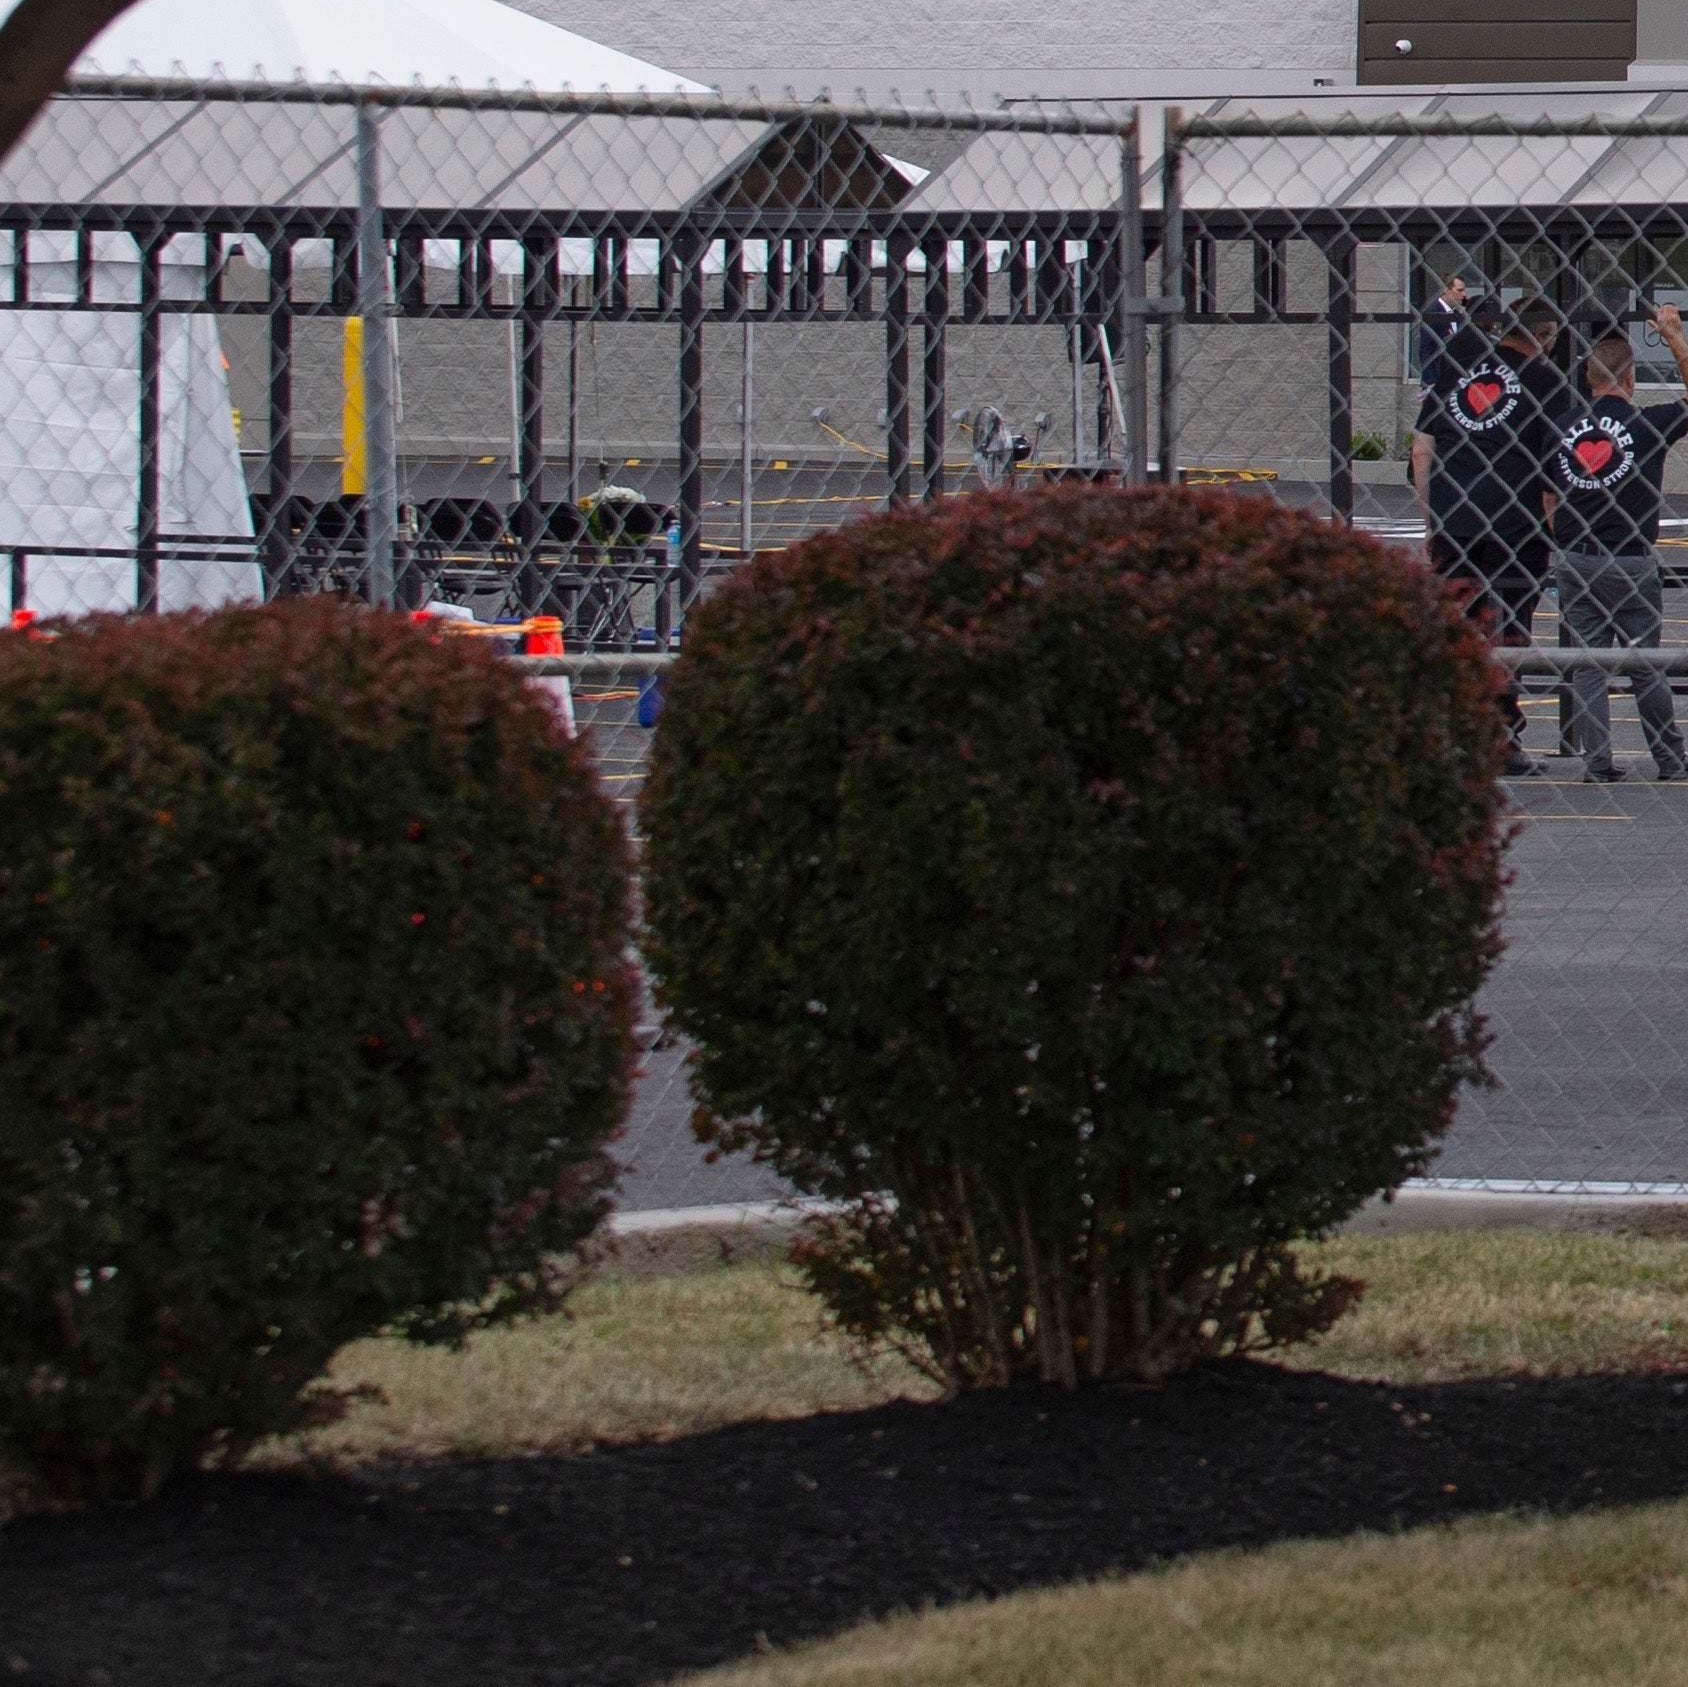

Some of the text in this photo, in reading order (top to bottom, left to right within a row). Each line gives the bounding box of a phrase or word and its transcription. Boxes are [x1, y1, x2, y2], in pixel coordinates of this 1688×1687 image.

[1458, 363, 1521, 394] ALL ONE
[1485, 398, 1519, 429] STRONG
[1561, 416, 1634, 451] ALL ONE
[1558, 451, 1635, 490] JEFFERSON STRONG
